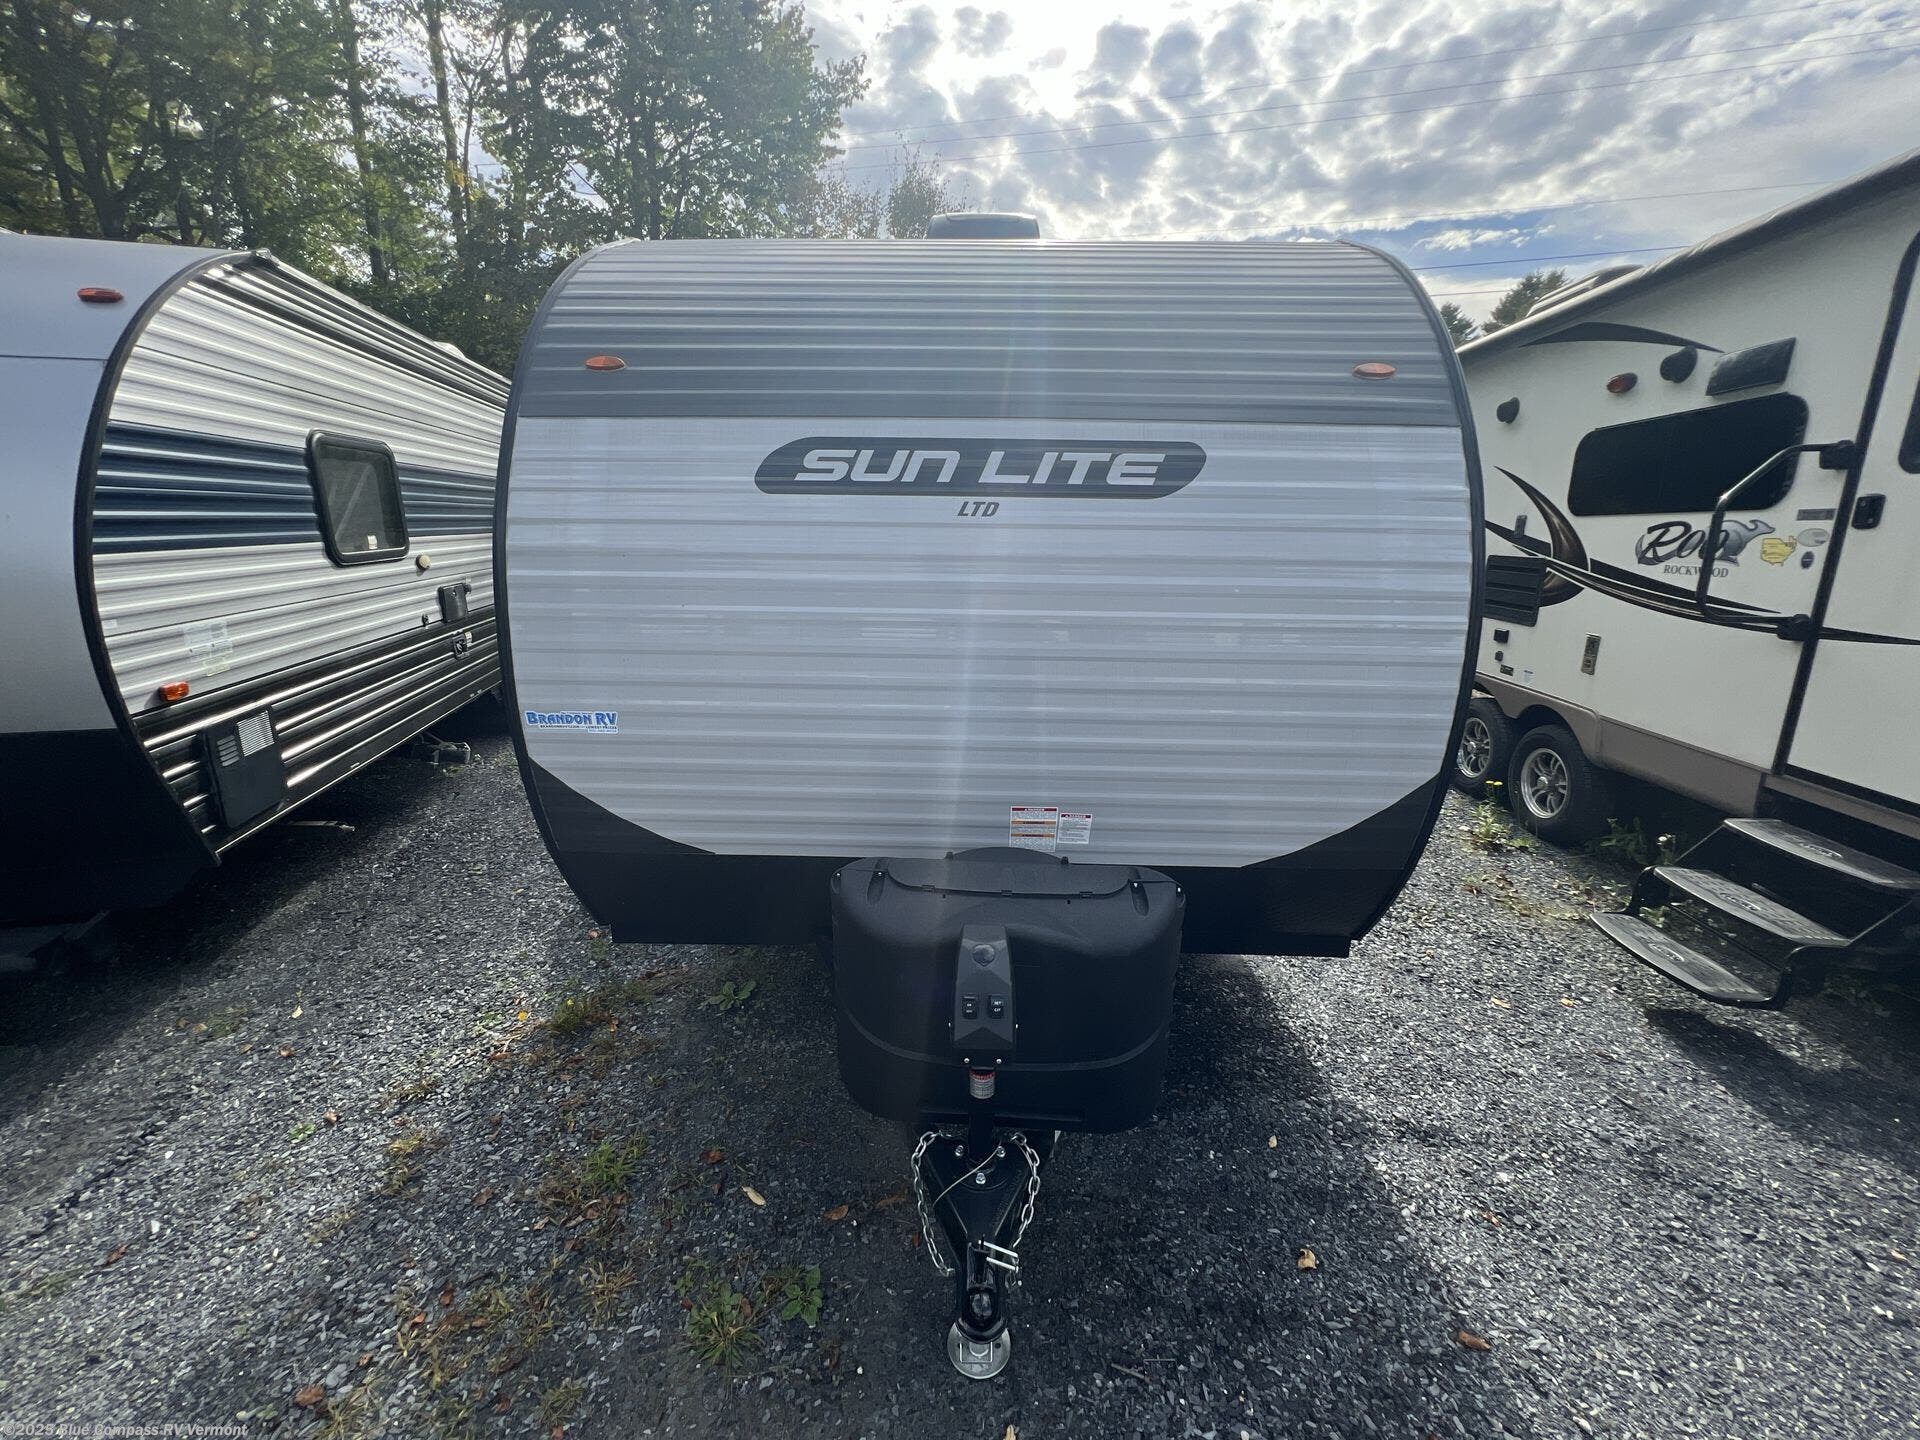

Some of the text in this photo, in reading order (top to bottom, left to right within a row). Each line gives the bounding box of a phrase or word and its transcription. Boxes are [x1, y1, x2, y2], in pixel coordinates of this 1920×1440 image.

[793, 448, 1167, 486] SUN LITE
[957, 501, 1000, 517] LTD
[1663, 564, 1729, 578] ROCKWOD
[595, 712, 617, 726] RV
